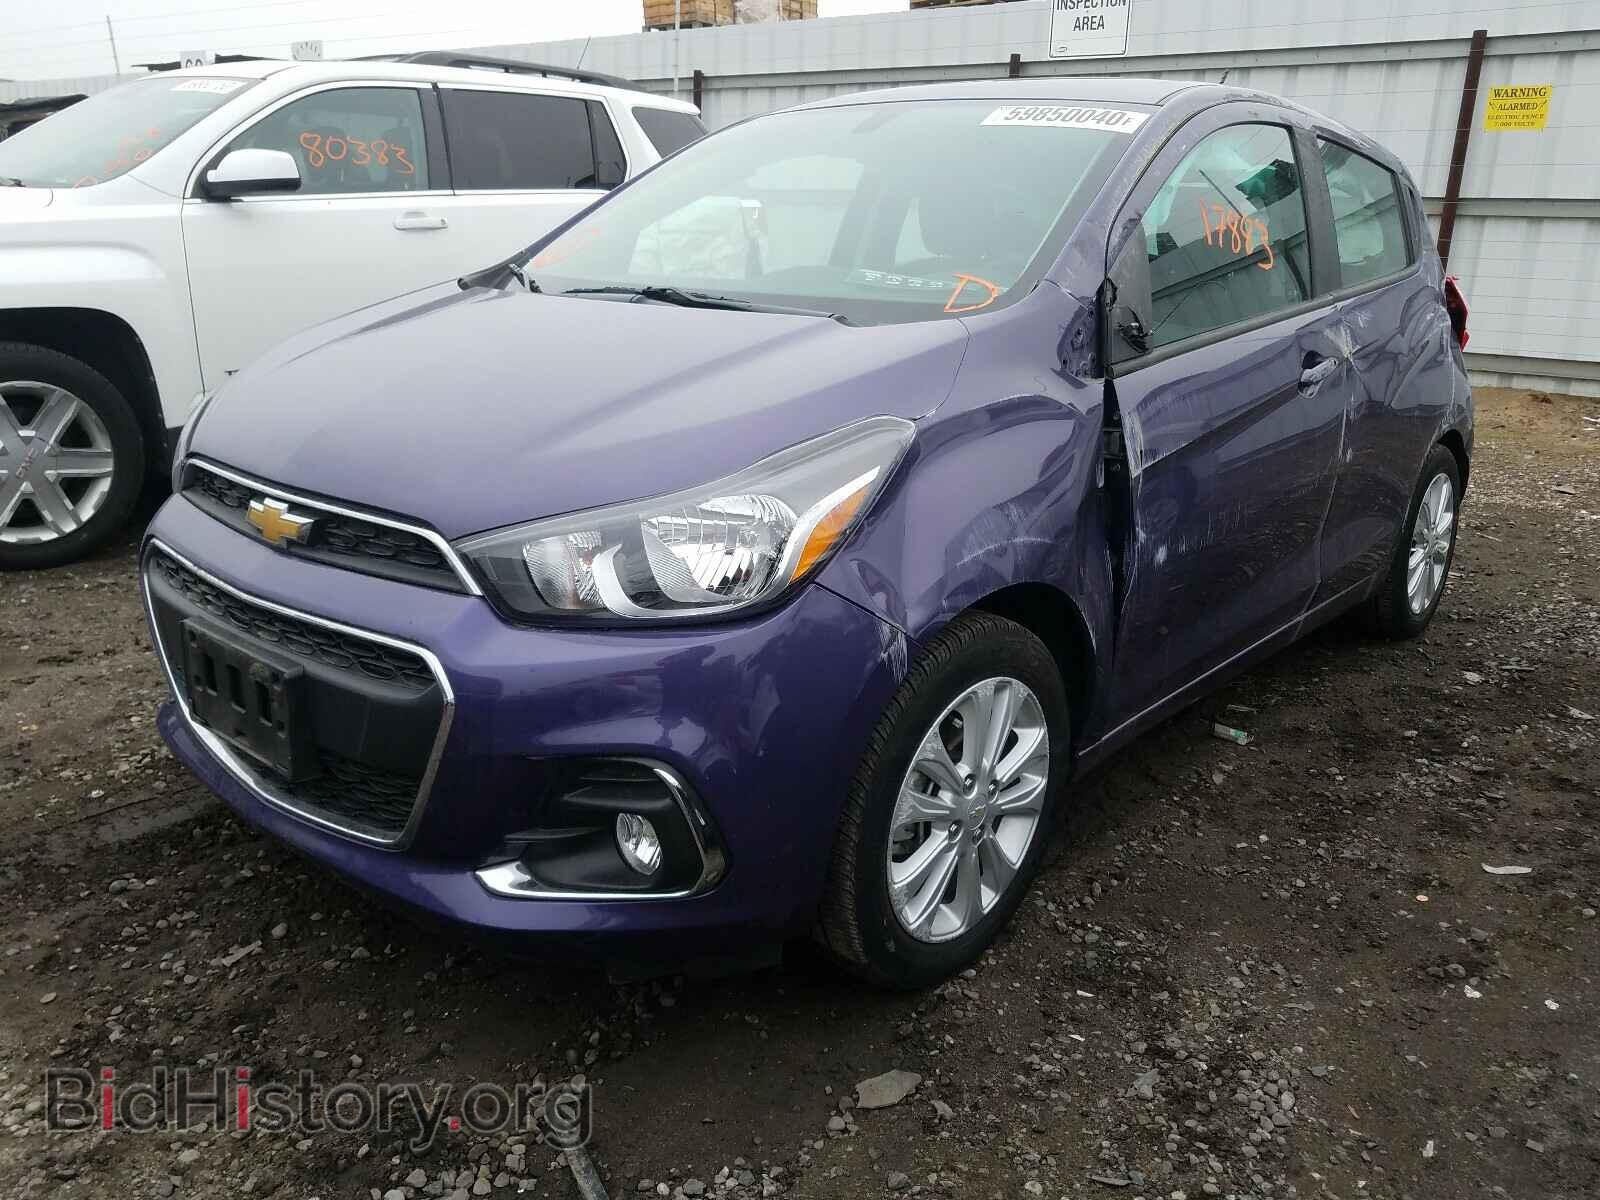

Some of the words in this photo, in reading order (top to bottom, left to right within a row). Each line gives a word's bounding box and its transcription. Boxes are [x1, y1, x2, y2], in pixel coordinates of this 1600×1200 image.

[1073, 15, 1105, 31] AREA
[1493, 87, 1547, 99] WARNING
[1497, 102, 1538, 111] ALARMED
[300, 132, 415, 175] 80383
[943, 271, 1000, 313] D
